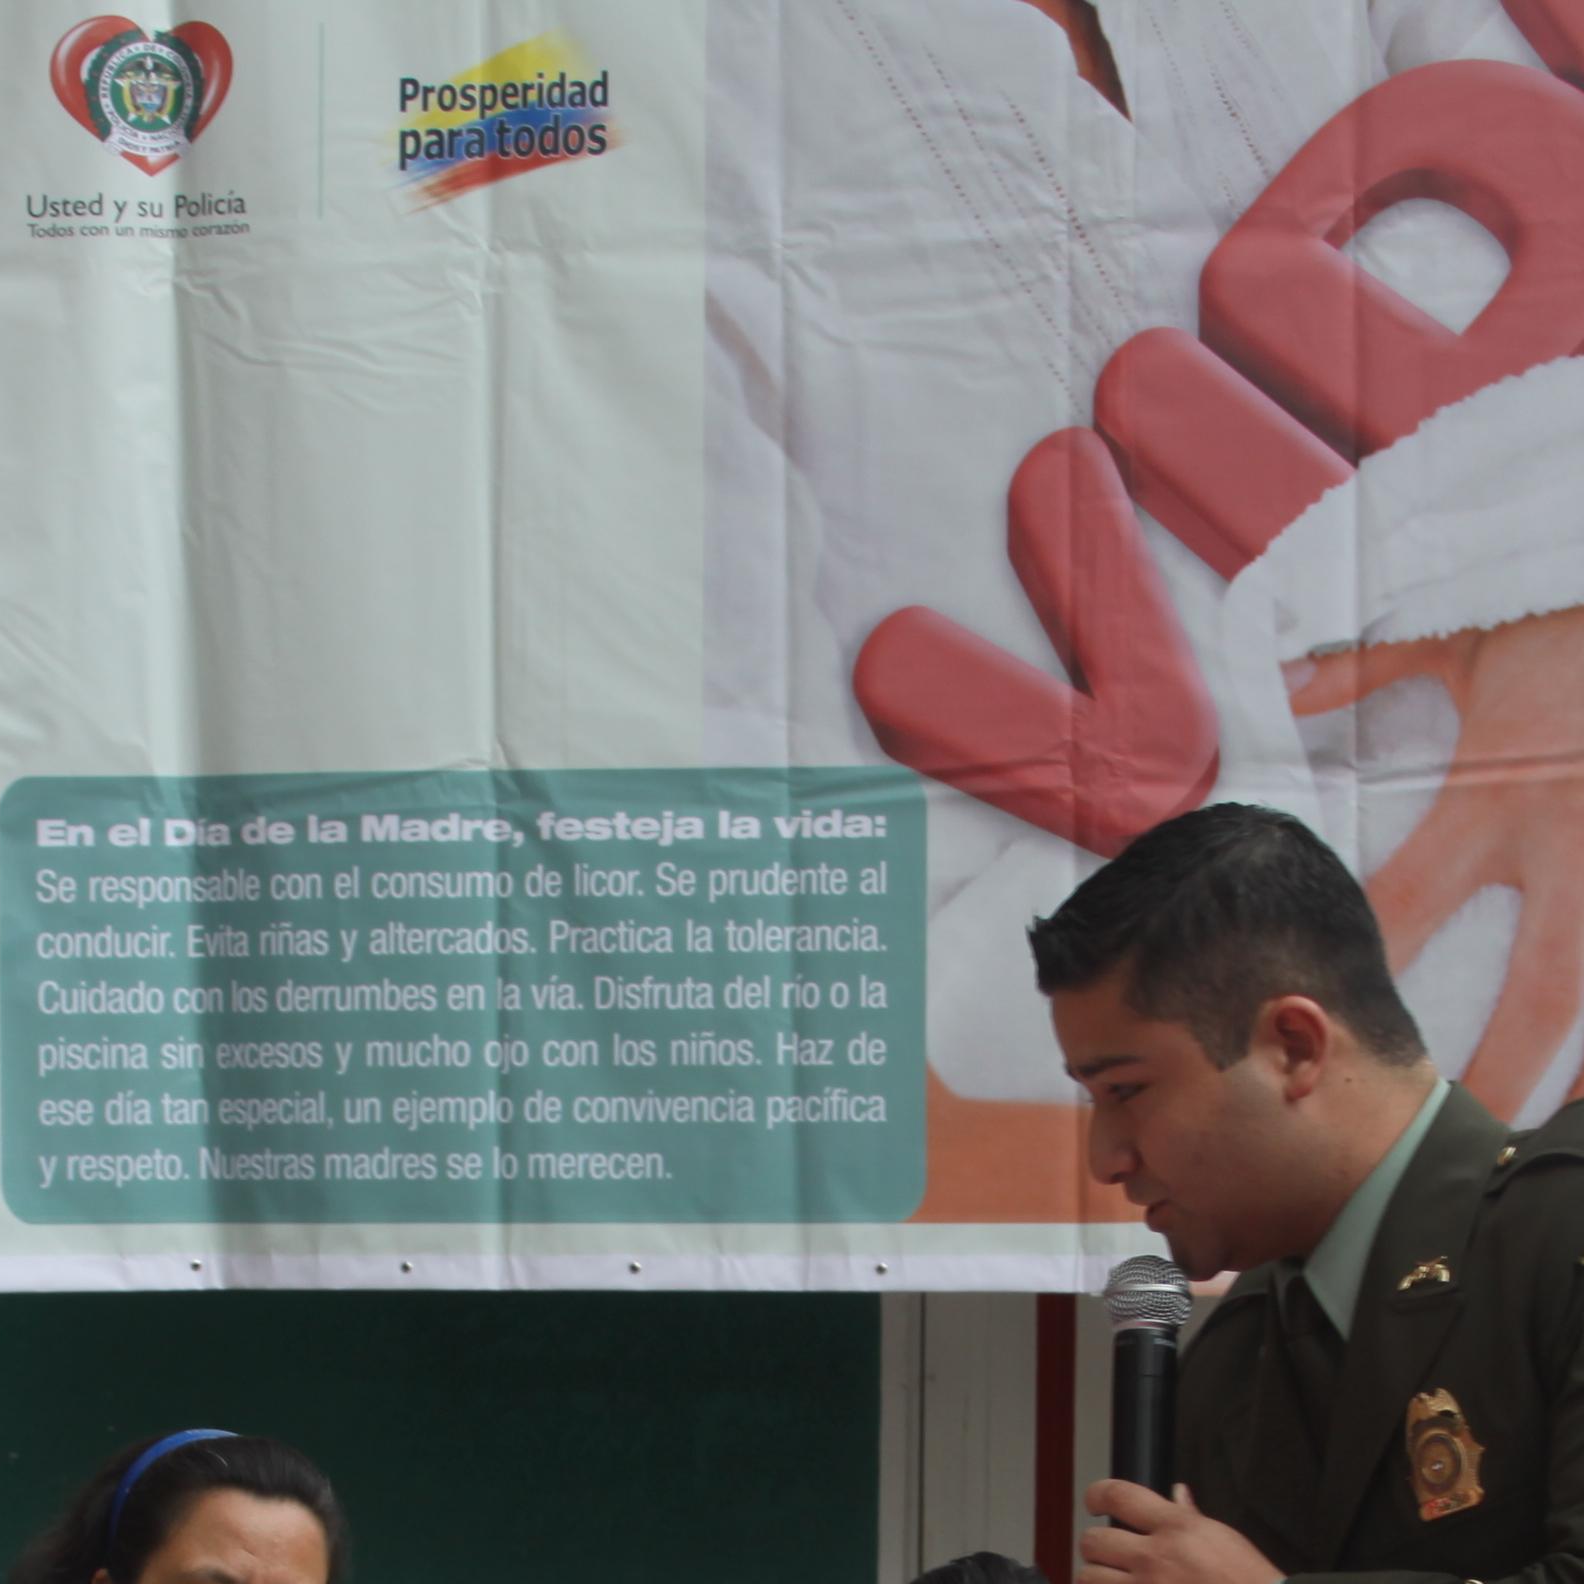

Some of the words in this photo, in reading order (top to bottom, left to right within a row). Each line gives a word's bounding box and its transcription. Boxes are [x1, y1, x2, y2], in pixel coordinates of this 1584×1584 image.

[399, 70, 609, 119] Prosperidad
[399, 126, 487, 171] para
[496, 112, 608, 158] todos
[26, 192, 104, 219] Usted
[113, 199, 128, 223] y
[137, 199, 164, 219] su
[174, 189, 247, 219] Policía
[27, 223, 75, 238] Todos
[79, 225, 110, 238] con
[115, 224, 135, 238] un
[139, 223, 188, 239] mismo
[190, 219, 251, 238] corazón
[36, 819, 95, 847] En
[108, 817, 151, 847] el
[164, 819, 231, 848] Día
[242, 816, 295, 845] de
[308, 814, 348, 843] la
[361, 811, 525, 848] Madre,
[536, 810, 704, 846] festeja
[718, 810, 761, 839] la
[773, 810, 887, 839] vida:
[37, 869, 76, 903] Se
[89, 869, 260, 908] responsable
[271, 873, 322, 900] con
[334, 866, 360, 899] el
[372, 871, 513, 899] consumo
[525, 864, 562, 897] de
[575, 864, 644, 897] licor.
[656, 862, 696, 896] Se
[709, 862, 848, 903] prudente
[860, 861, 887, 895] al
[37, 925, 175, 959] conducir.
[188, 925, 249, 957] Evita
[260, 922, 329, 956] riñas
[340, 929, 358, 962] y
[369, 920, 536, 955] altercados.
[550, 920, 673, 953] Practica
[686, 919, 713, 953] la
[725, 917, 887, 952] tolerancia.
[38, 980, 164, 1014] Cuidado
[173, 987, 223, 1014] con
[232, 981, 267, 1013] los
[276, 978, 437, 1012] derrumbes
[447, 984, 485, 1011] en
[499, 980, 521, 1010] la
[530, 975, 584, 1010] vía.
[594, 976, 714, 1010] Disfruta
[724, 975, 770, 1009] del
[782, 976, 820, 1009] río
[830, 982, 849, 1009] o
[860, 974, 888, 1008] la
[38, 1036, 149, 1077] piscina
[161, 1036, 203, 1069] sin
[217, 1042, 323, 1068] excesos
[335, 1042, 352, 1075] y
[366, 1033, 471, 1067] mucho
[484, 1033, 529, 1075] ojo
[542, 1040, 598, 1067] con
[614, 1033, 657, 1066] los
[671, 1031, 761, 1066] niños.
[777, 1032, 834, 1065] Haz
[848, 1031, 886, 1065] de
[39, 1099, 94, 1126] ese
[105, 1090, 152, 1125] día
[161, 1093, 208, 1125] tan
[219, 1091, 333, 1130] especial,
[344, 1097, 381, 1124] un
[393, 1089, 513, 1131] ejemplo
[524, 1090, 562, 1123] de
[573, 1089, 755, 1123] convivencia
[767, 1086, 887, 1129] pacífica
[39, 1156, 58, 1188] y
[67, 1148, 189, 1187] respeto.
[200, 1147, 315, 1180] Nuestras
[325, 1146, 437, 1180] madres
[447, 1153, 482, 1180] se
[493, 1146, 518, 1179] lo
[528, 1153, 672, 1179] merecen.
